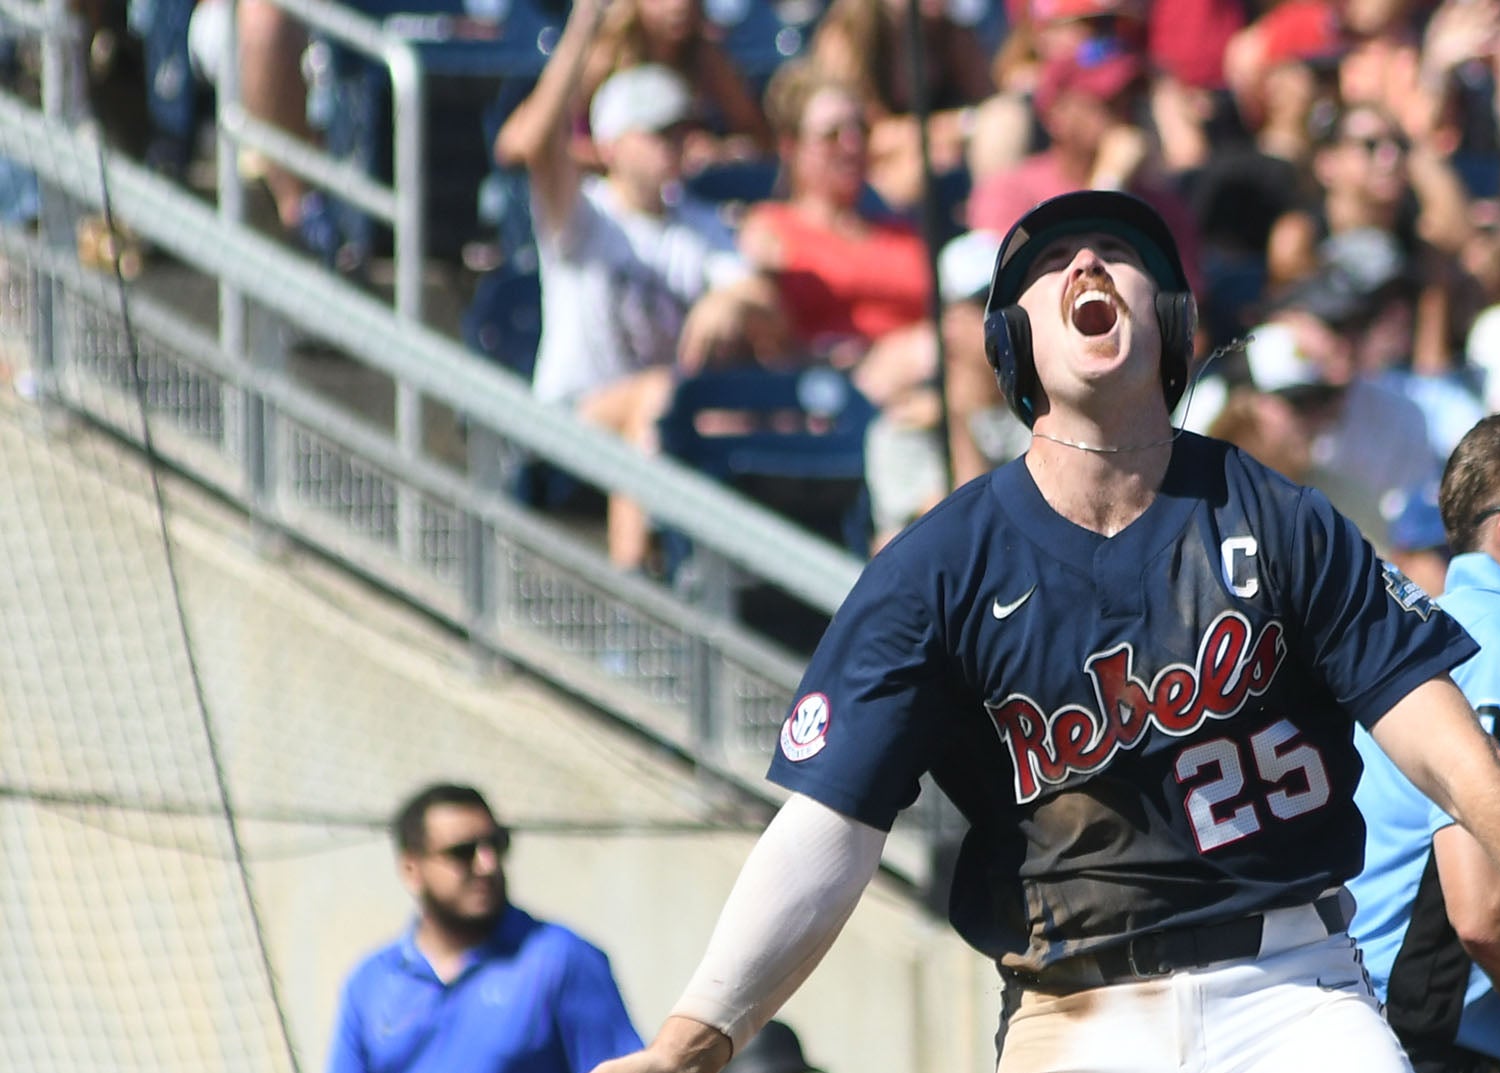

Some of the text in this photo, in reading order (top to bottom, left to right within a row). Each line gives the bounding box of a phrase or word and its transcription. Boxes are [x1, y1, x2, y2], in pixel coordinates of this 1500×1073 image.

[1221, 536, 1258, 598] C
[983, 610, 1288, 805] Rebels
[1174, 718, 1331, 855] 25
